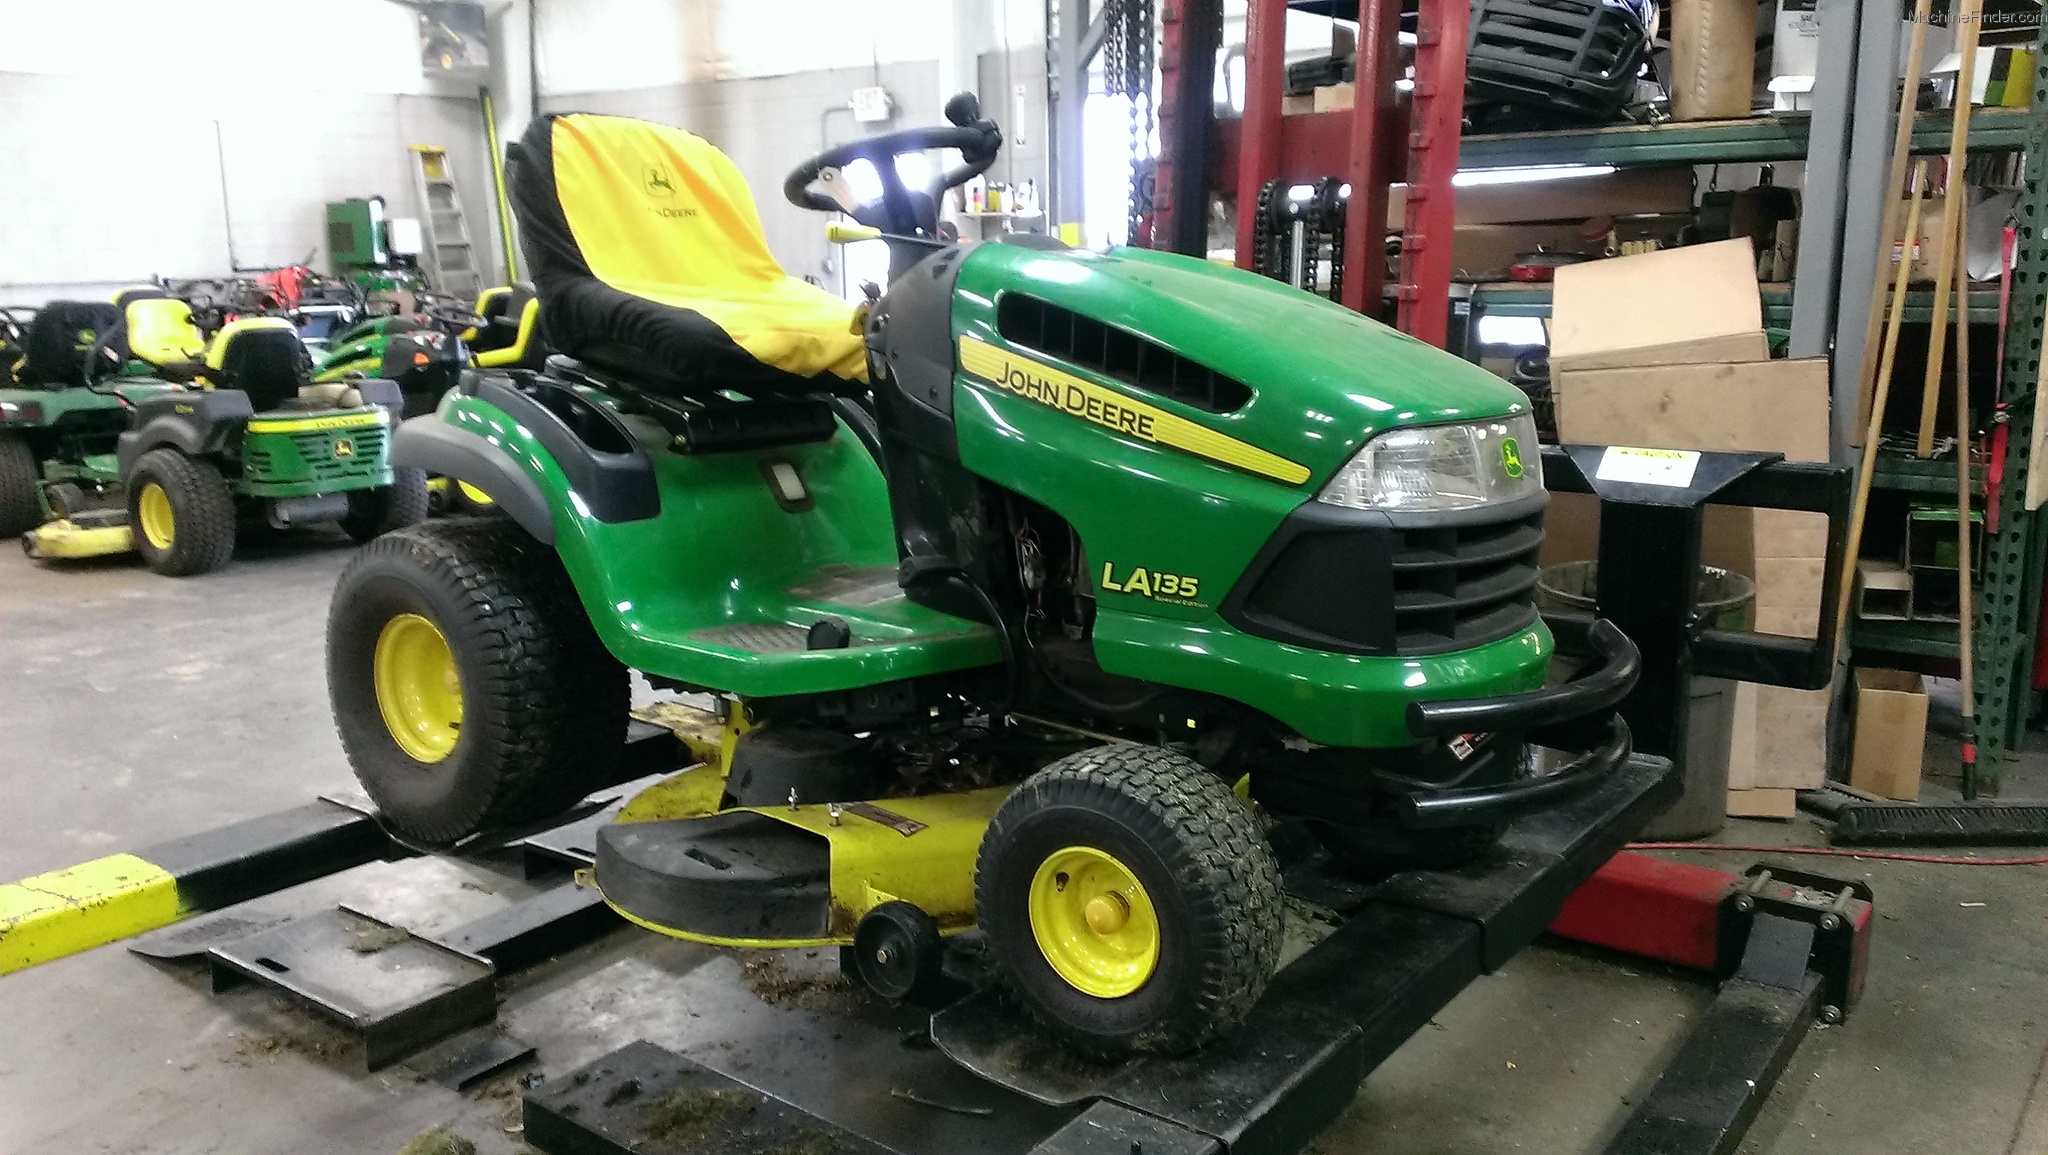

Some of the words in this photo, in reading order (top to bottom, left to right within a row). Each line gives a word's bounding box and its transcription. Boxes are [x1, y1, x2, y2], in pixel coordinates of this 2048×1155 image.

[996, 361, 1060, 405] JOHN
[1066, 384, 1155, 437] DEERE
[1101, 561, 1199, 598] LA135
